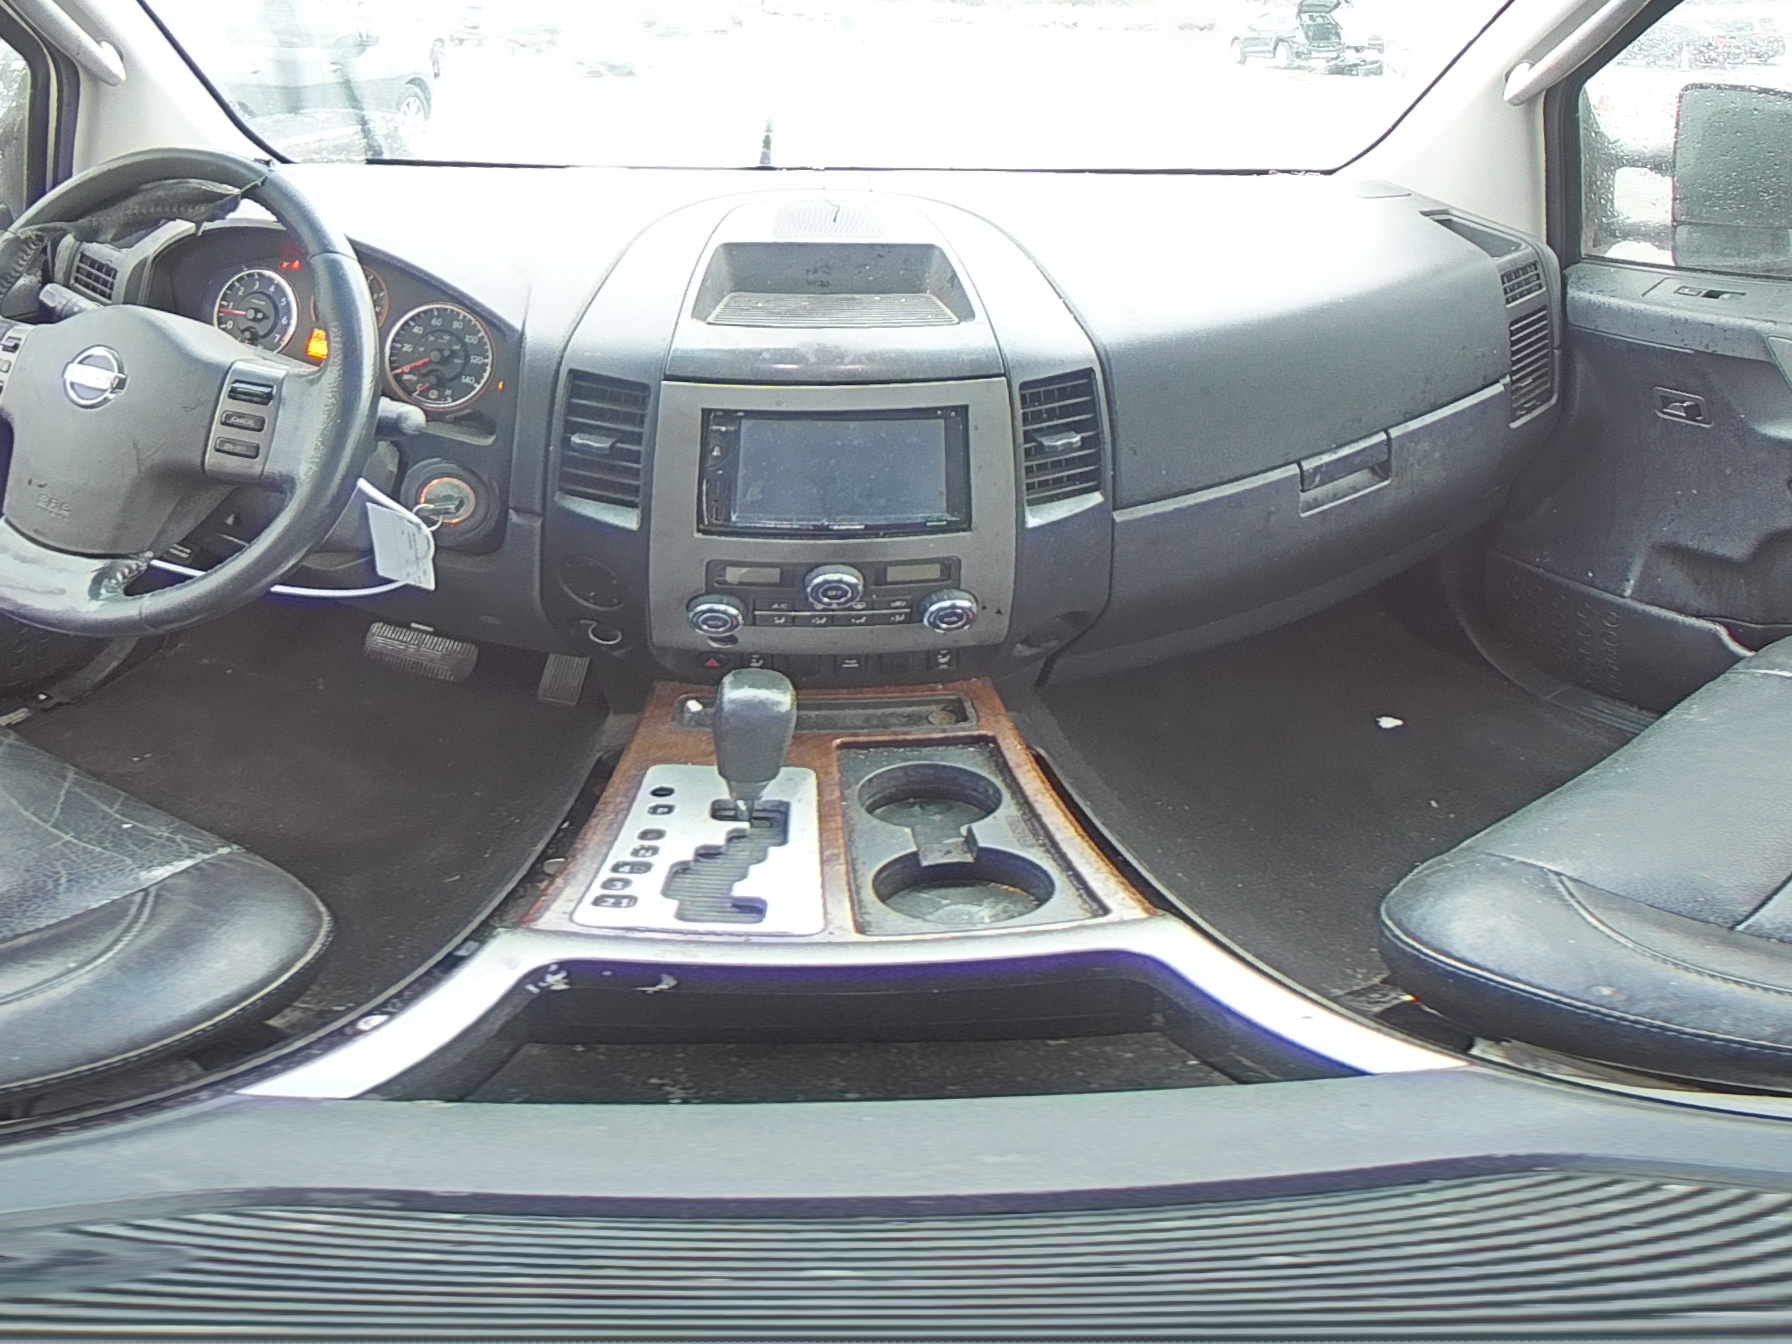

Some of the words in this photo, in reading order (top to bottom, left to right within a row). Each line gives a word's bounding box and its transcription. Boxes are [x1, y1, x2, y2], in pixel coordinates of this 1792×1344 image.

[281, 316, 288, 325] 6
[430, 317, 443, 326] 60
[452, 320, 464, 329] 80
[412, 325, 424, 334] 40
[464, 335, 479, 344] 100
[402, 343, 414, 352] 20
[470, 355, 484, 364] 120
[461, 375, 475, 384] 140
